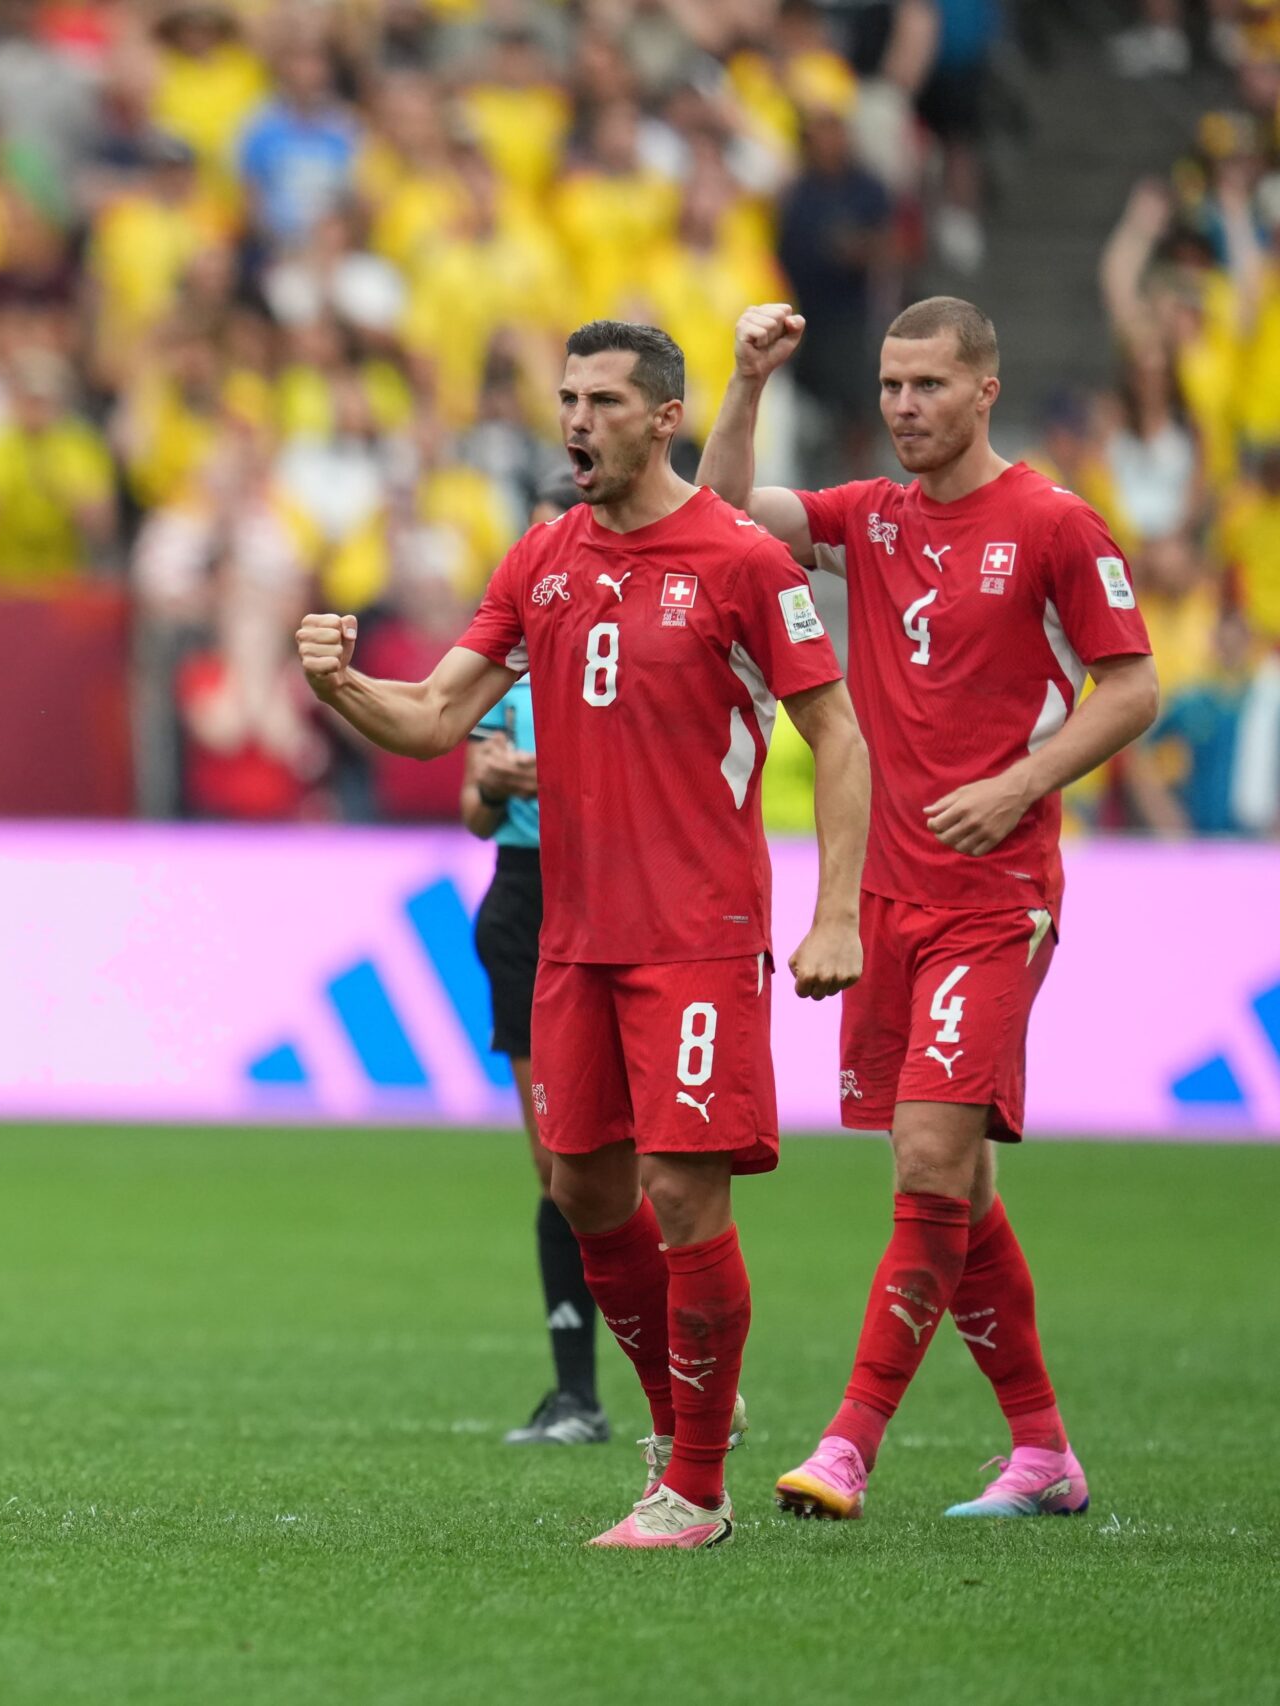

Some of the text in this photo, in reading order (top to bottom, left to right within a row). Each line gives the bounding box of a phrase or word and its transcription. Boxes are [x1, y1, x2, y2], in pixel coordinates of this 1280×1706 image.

[583, 622, 619, 707] 8
[903, 588, 937, 665] 4
[677, 1002, 718, 1086] 8
[930, 965, 969, 1043] 4
